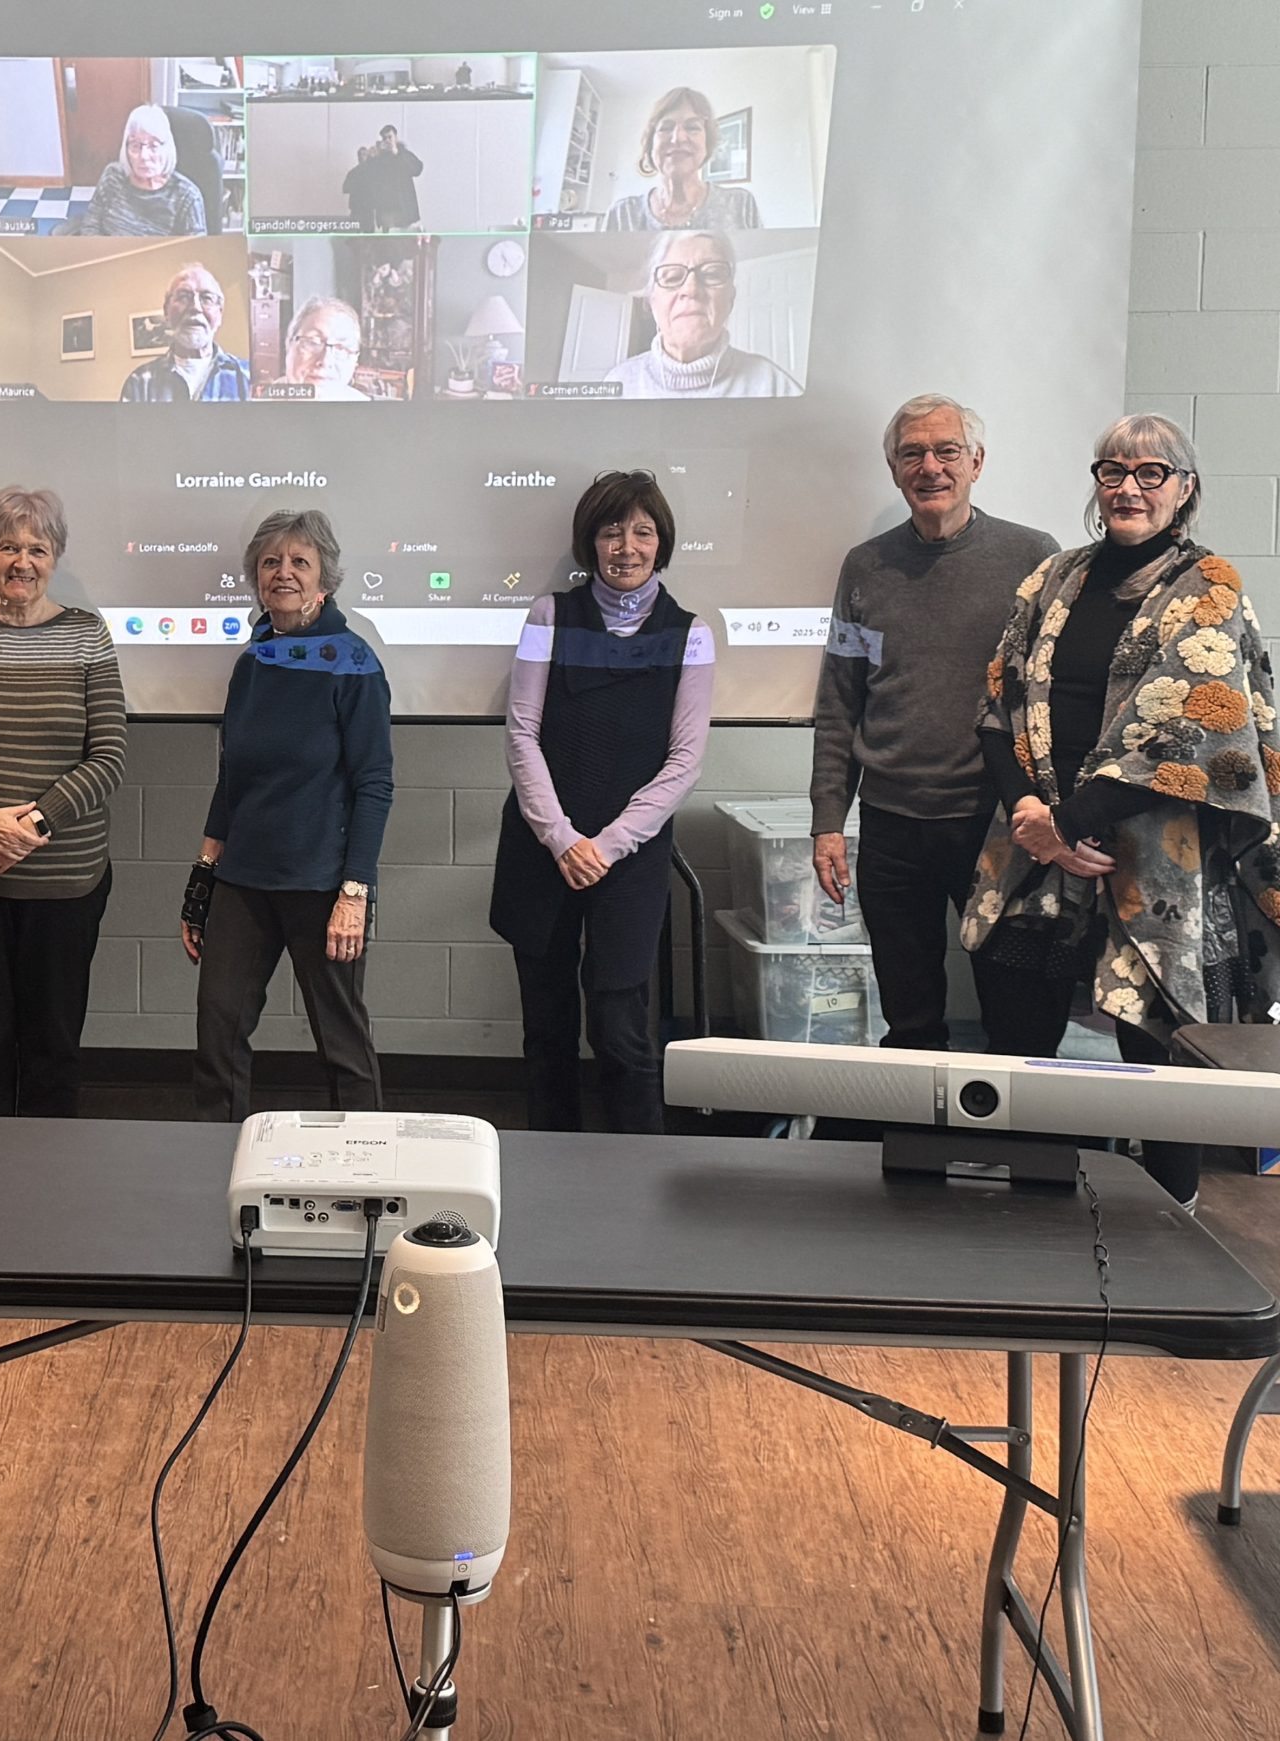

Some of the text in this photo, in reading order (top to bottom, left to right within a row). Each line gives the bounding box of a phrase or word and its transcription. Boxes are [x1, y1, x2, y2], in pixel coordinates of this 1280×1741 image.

[708, 8, 743, 20] Sign in
[792, 5, 815, 15] View
[268, 386, 285, 397] Lise
[542, 385, 578, 395] Carmen
[176, 471, 328, 489] Lorraine Gandolfo
[484, 470, 557, 488] Jacinthe
[139, 542, 218, 552] Lorraine Gandolfo
[402, 543, 438, 552] Jacinthe
[205, 593, 252, 604] Participants
[361, 593, 384, 602] React
[428, 593, 452, 602] Share
[482, 593, 491, 602] AI
